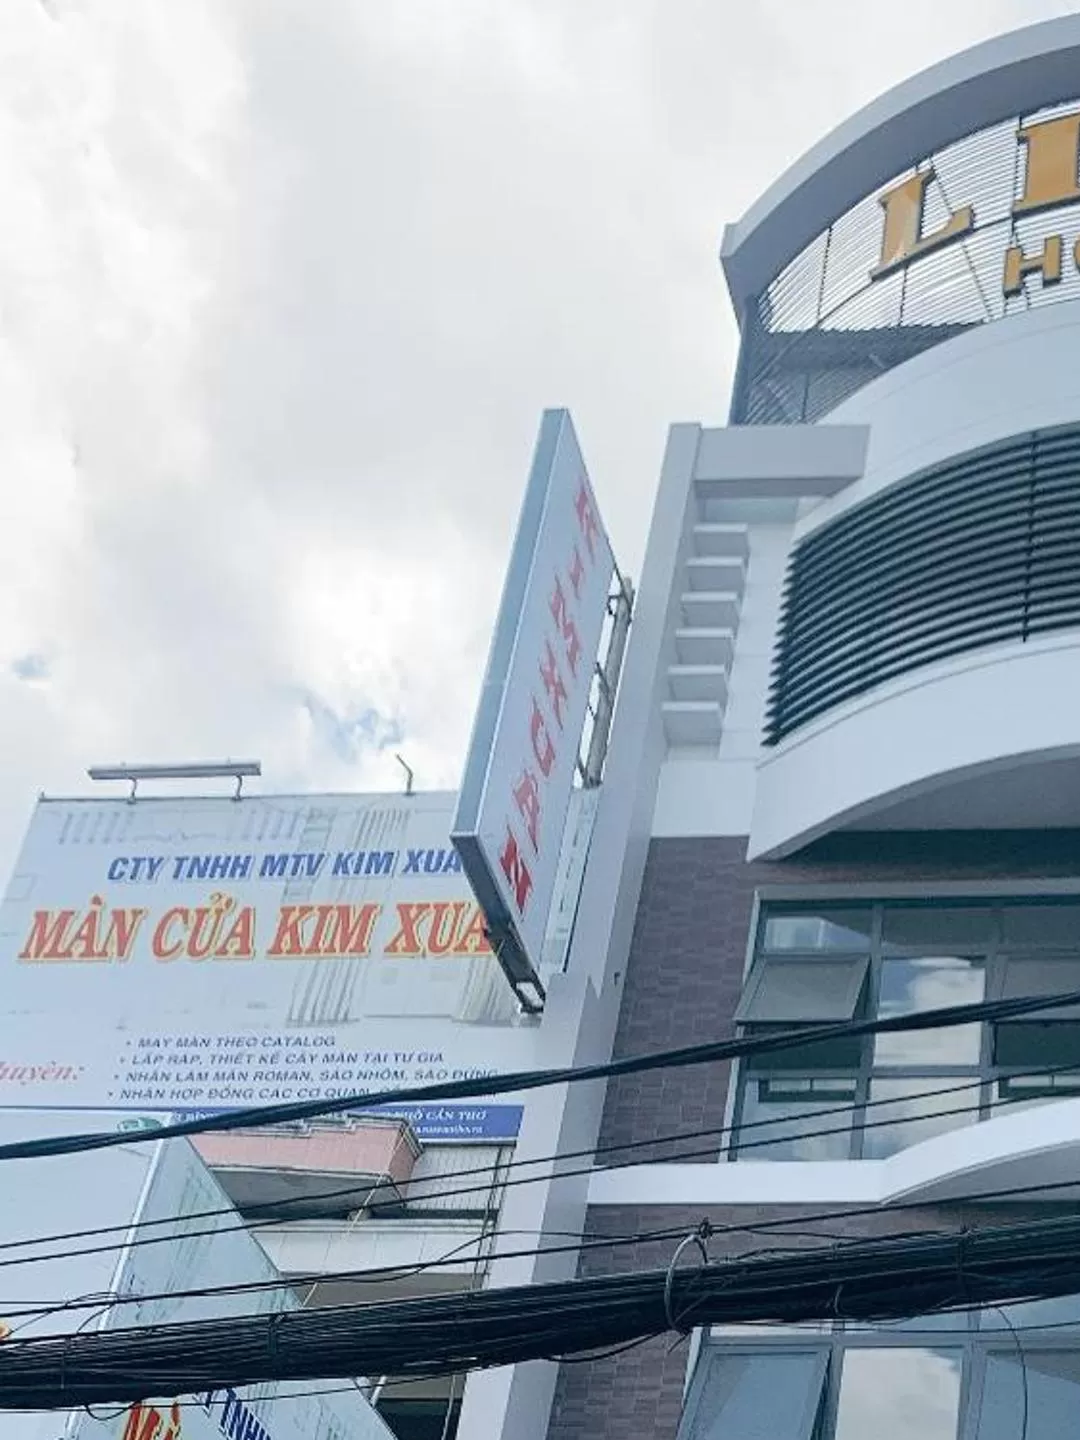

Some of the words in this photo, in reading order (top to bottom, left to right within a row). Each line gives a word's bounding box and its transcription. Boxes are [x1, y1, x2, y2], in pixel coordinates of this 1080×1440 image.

[108, 856, 164, 881] CTY
[172, 854, 252, 880] TNHH
[258, 852, 325, 877] MTV
[331, 851, 395, 876] KIM
[401, 848, 464, 874] XUA
[152, 891, 255, 961] CỬA
[266, 901, 383, 958] KIM
[383, 901, 497, 958] XUA
[216, 1036, 259, 1048] THEO
[262, 1035, 337, 1048] CATALOG
